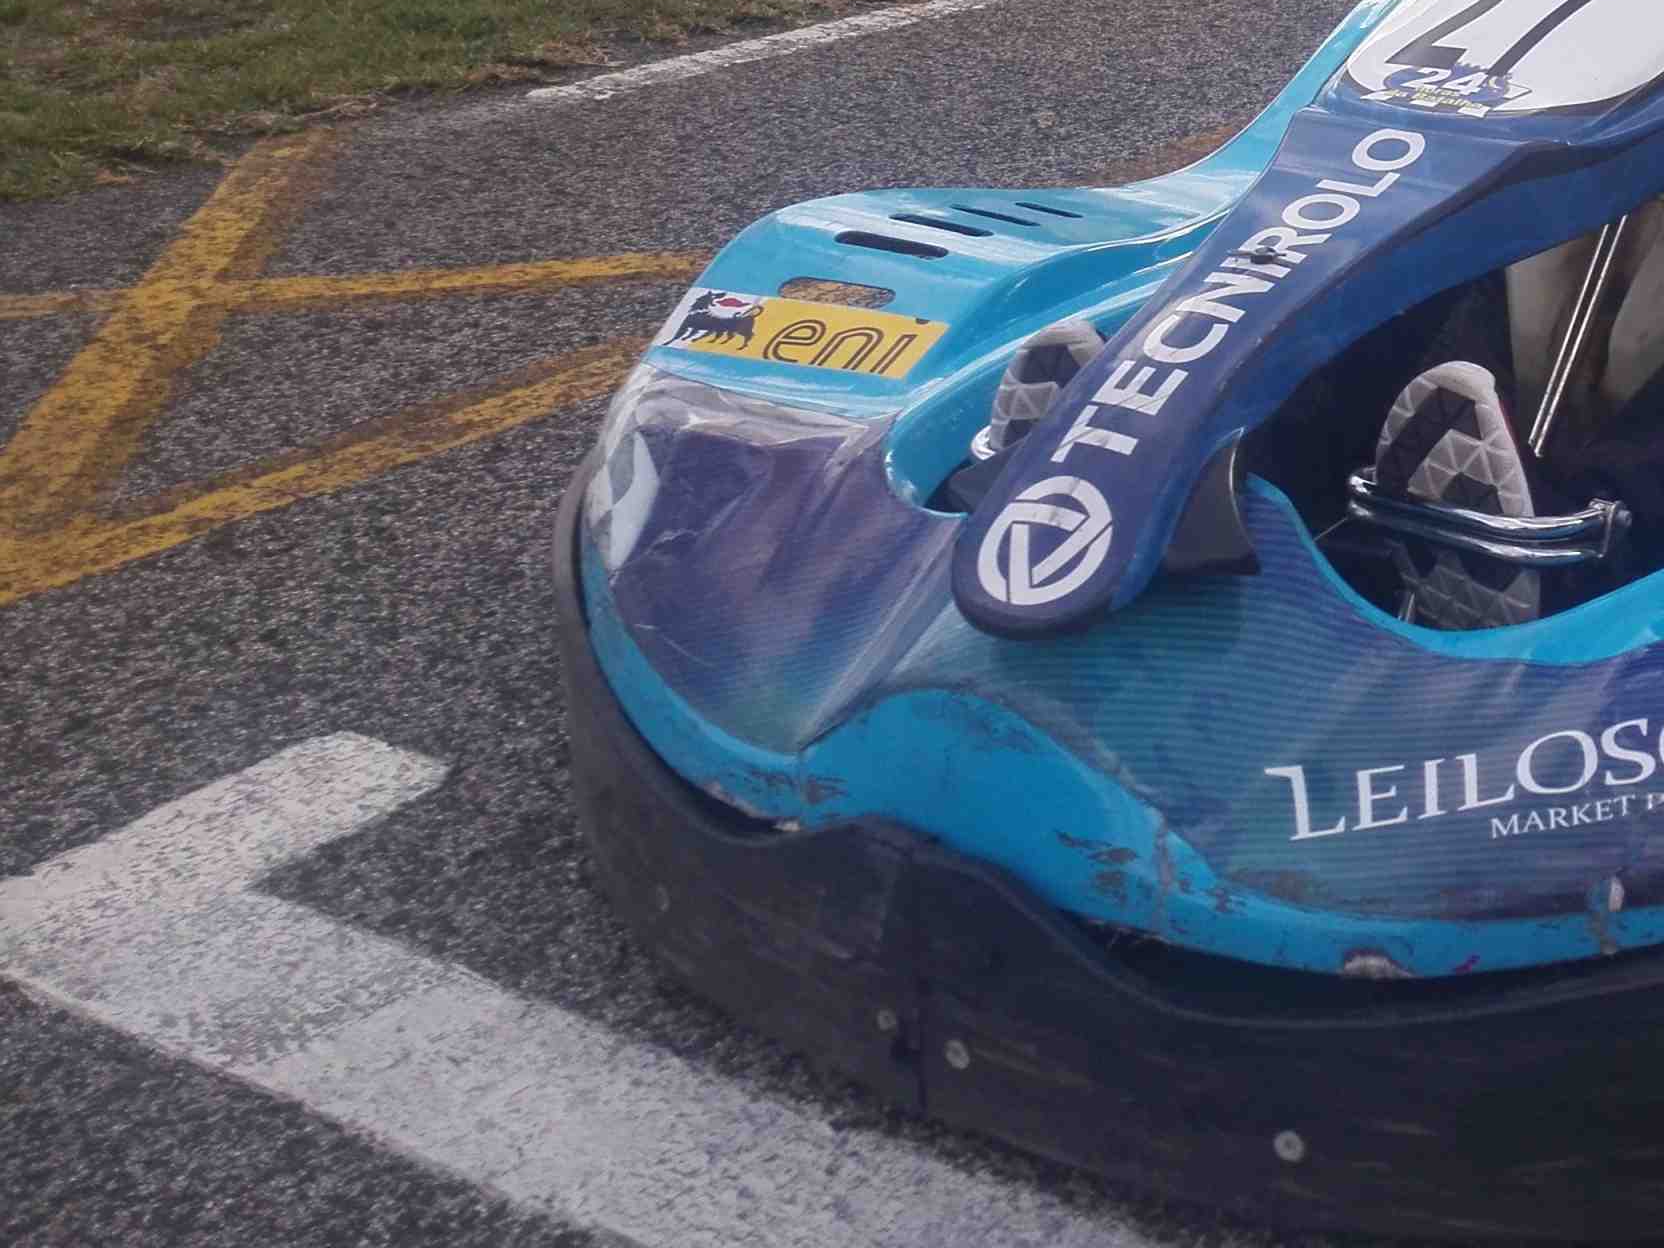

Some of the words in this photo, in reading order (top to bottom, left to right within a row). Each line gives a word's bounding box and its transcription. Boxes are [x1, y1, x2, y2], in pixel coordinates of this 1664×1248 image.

[1399, 66, 1489, 97] 24
[1051, 129, 1426, 463] TECNIROLO
[763, 317, 930, 374] eni
[1491, 794, 1632, 839] MARKET
